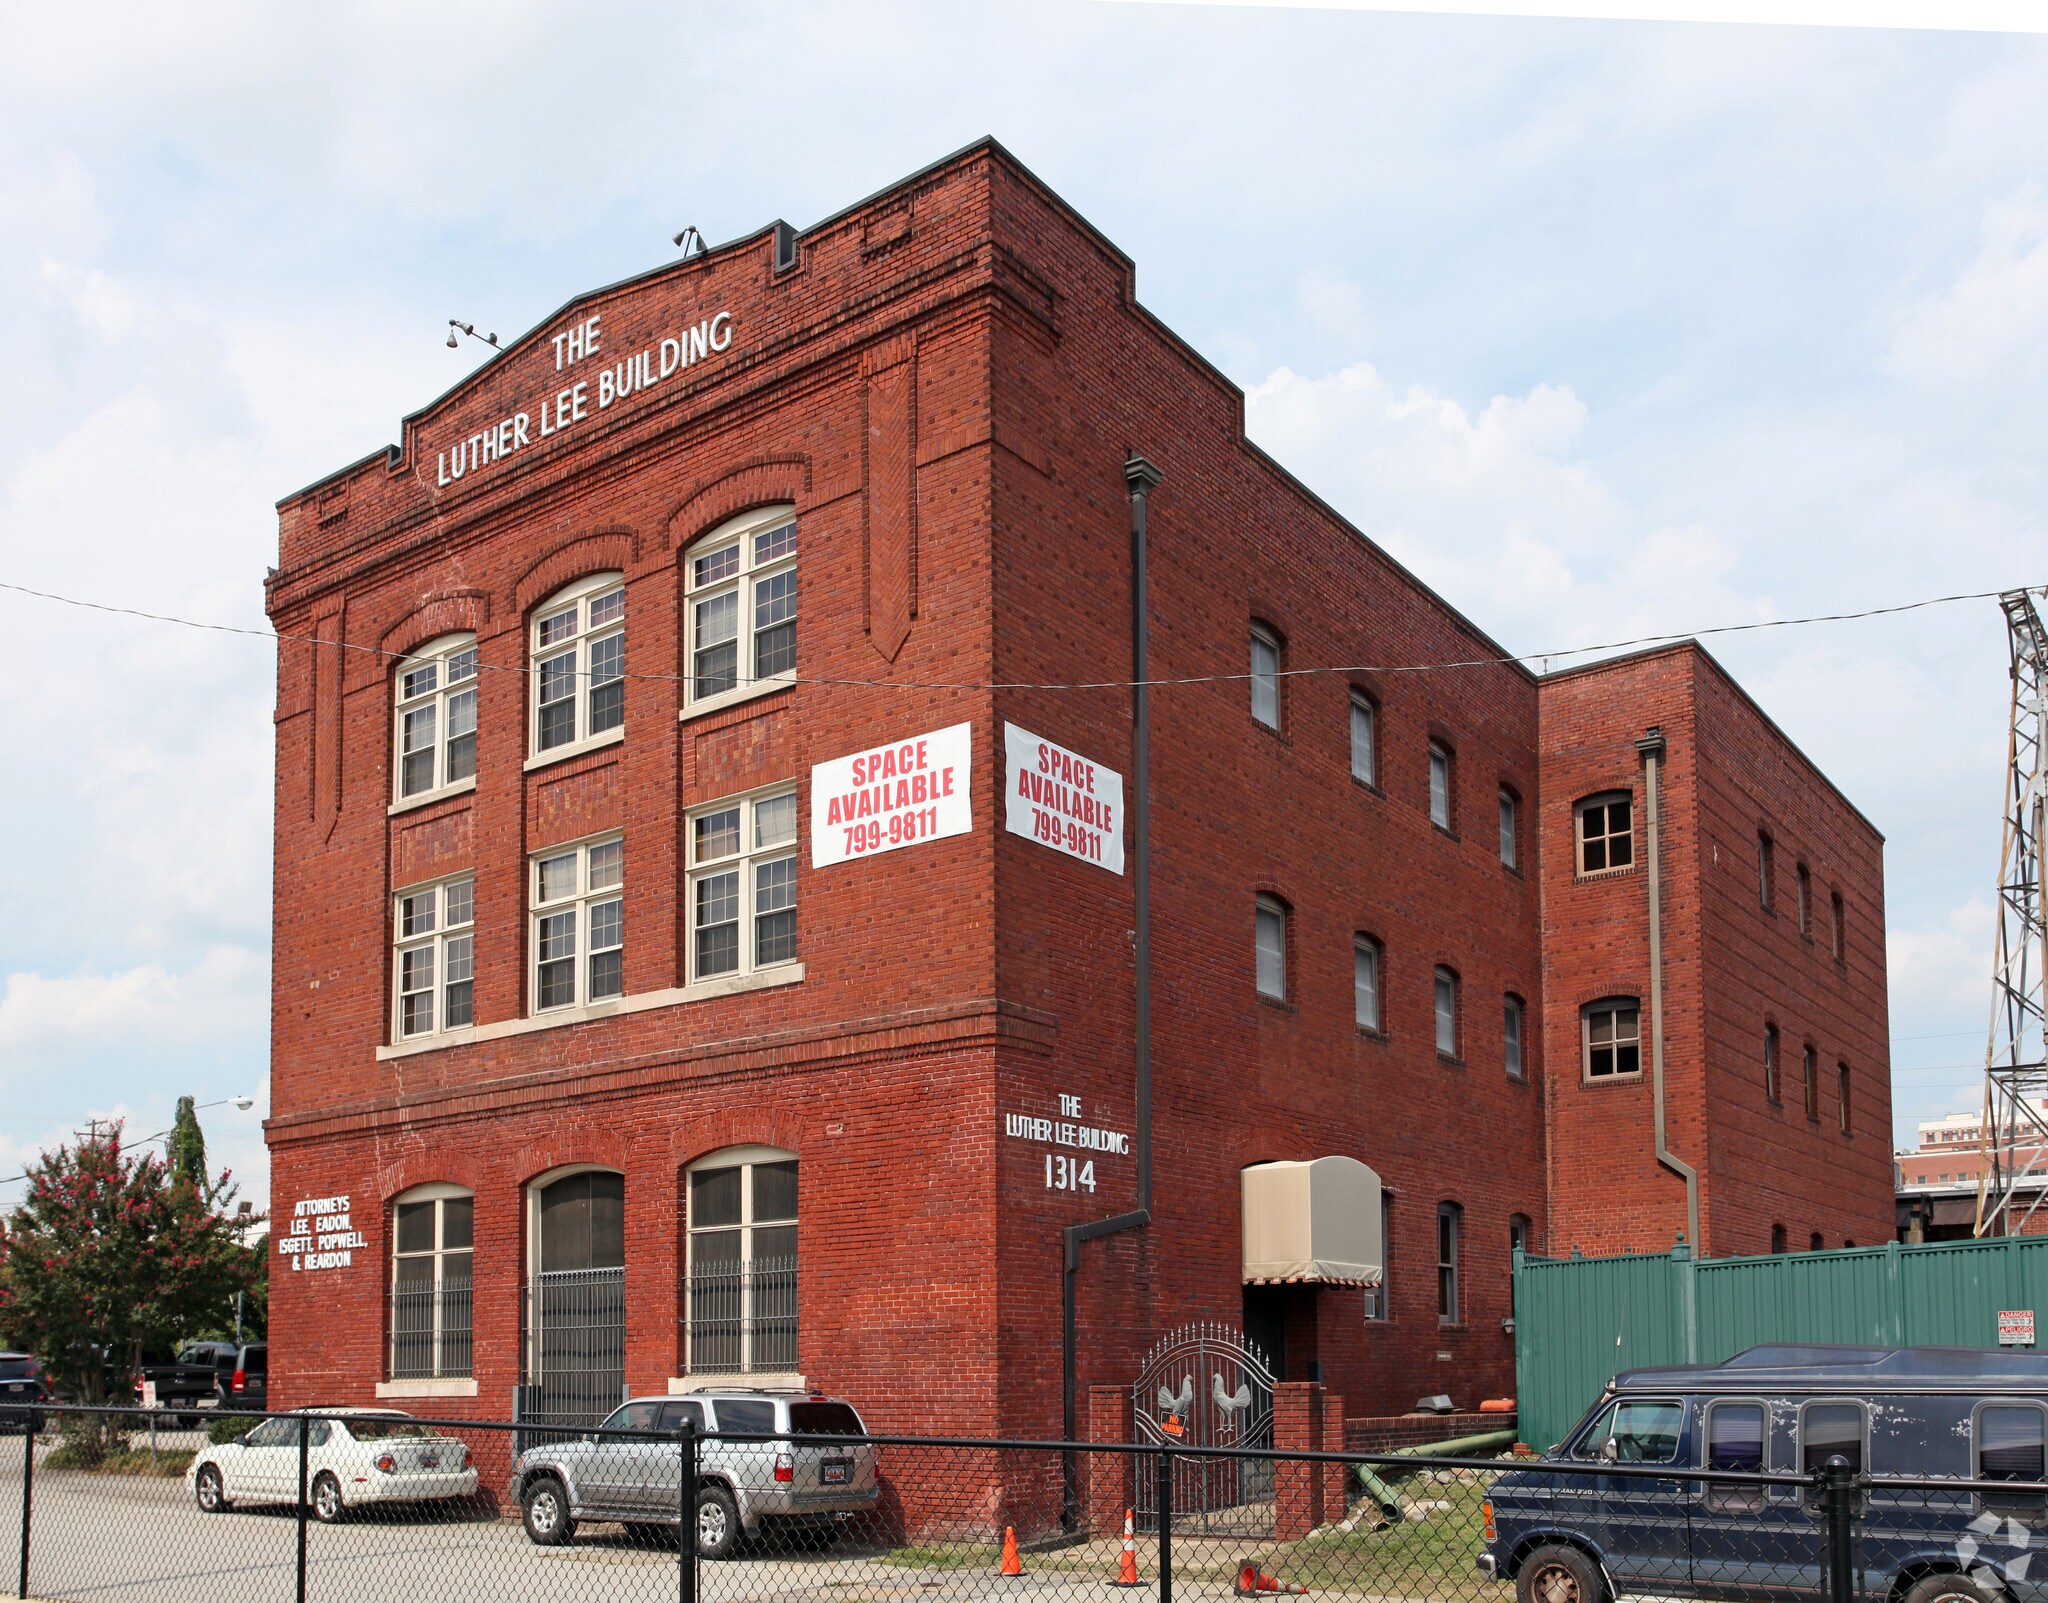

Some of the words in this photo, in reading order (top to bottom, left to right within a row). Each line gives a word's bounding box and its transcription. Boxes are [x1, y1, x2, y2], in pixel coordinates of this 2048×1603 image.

[551, 315, 601, 371] THE
[438, 412, 530, 486] LUTHER
[541, 381, 588, 437] LEE
[599, 311, 732, 409] BUILDING
[852, 740, 928, 787] SPACE
[1038, 743, 1095, 794] SPACE
[827, 766, 954, 826] AVAILABLE
[1018, 768, 1113, 834] AVAILABLE
[843, 806, 937, 856] 799-9811
[1031, 807, 1102, 862] 799-9811
[1058, 1093, 1082, 1118] THE
[1006, 1113, 1053, 1143] LUTHER
[1055, 1121, 1077, 1147] LEE
[1079, 1126, 1129, 1155] BUILDING
[1045, 1154, 1096, 1193] 1314
[290, 1218, 311, 1236] LEE,
[315, 1214, 353, 1233] EADON,
[294, 1195, 351, 1217] ATTORNEYS
[279, 1236, 314, 1254] ISGETT,
[318, 1231, 368, 1251] POPWELL,
[292, 1255, 302, 1271] &
[304, 1250, 352, 1270] REARDON
[1168, 1414, 1180, 1424] NO
